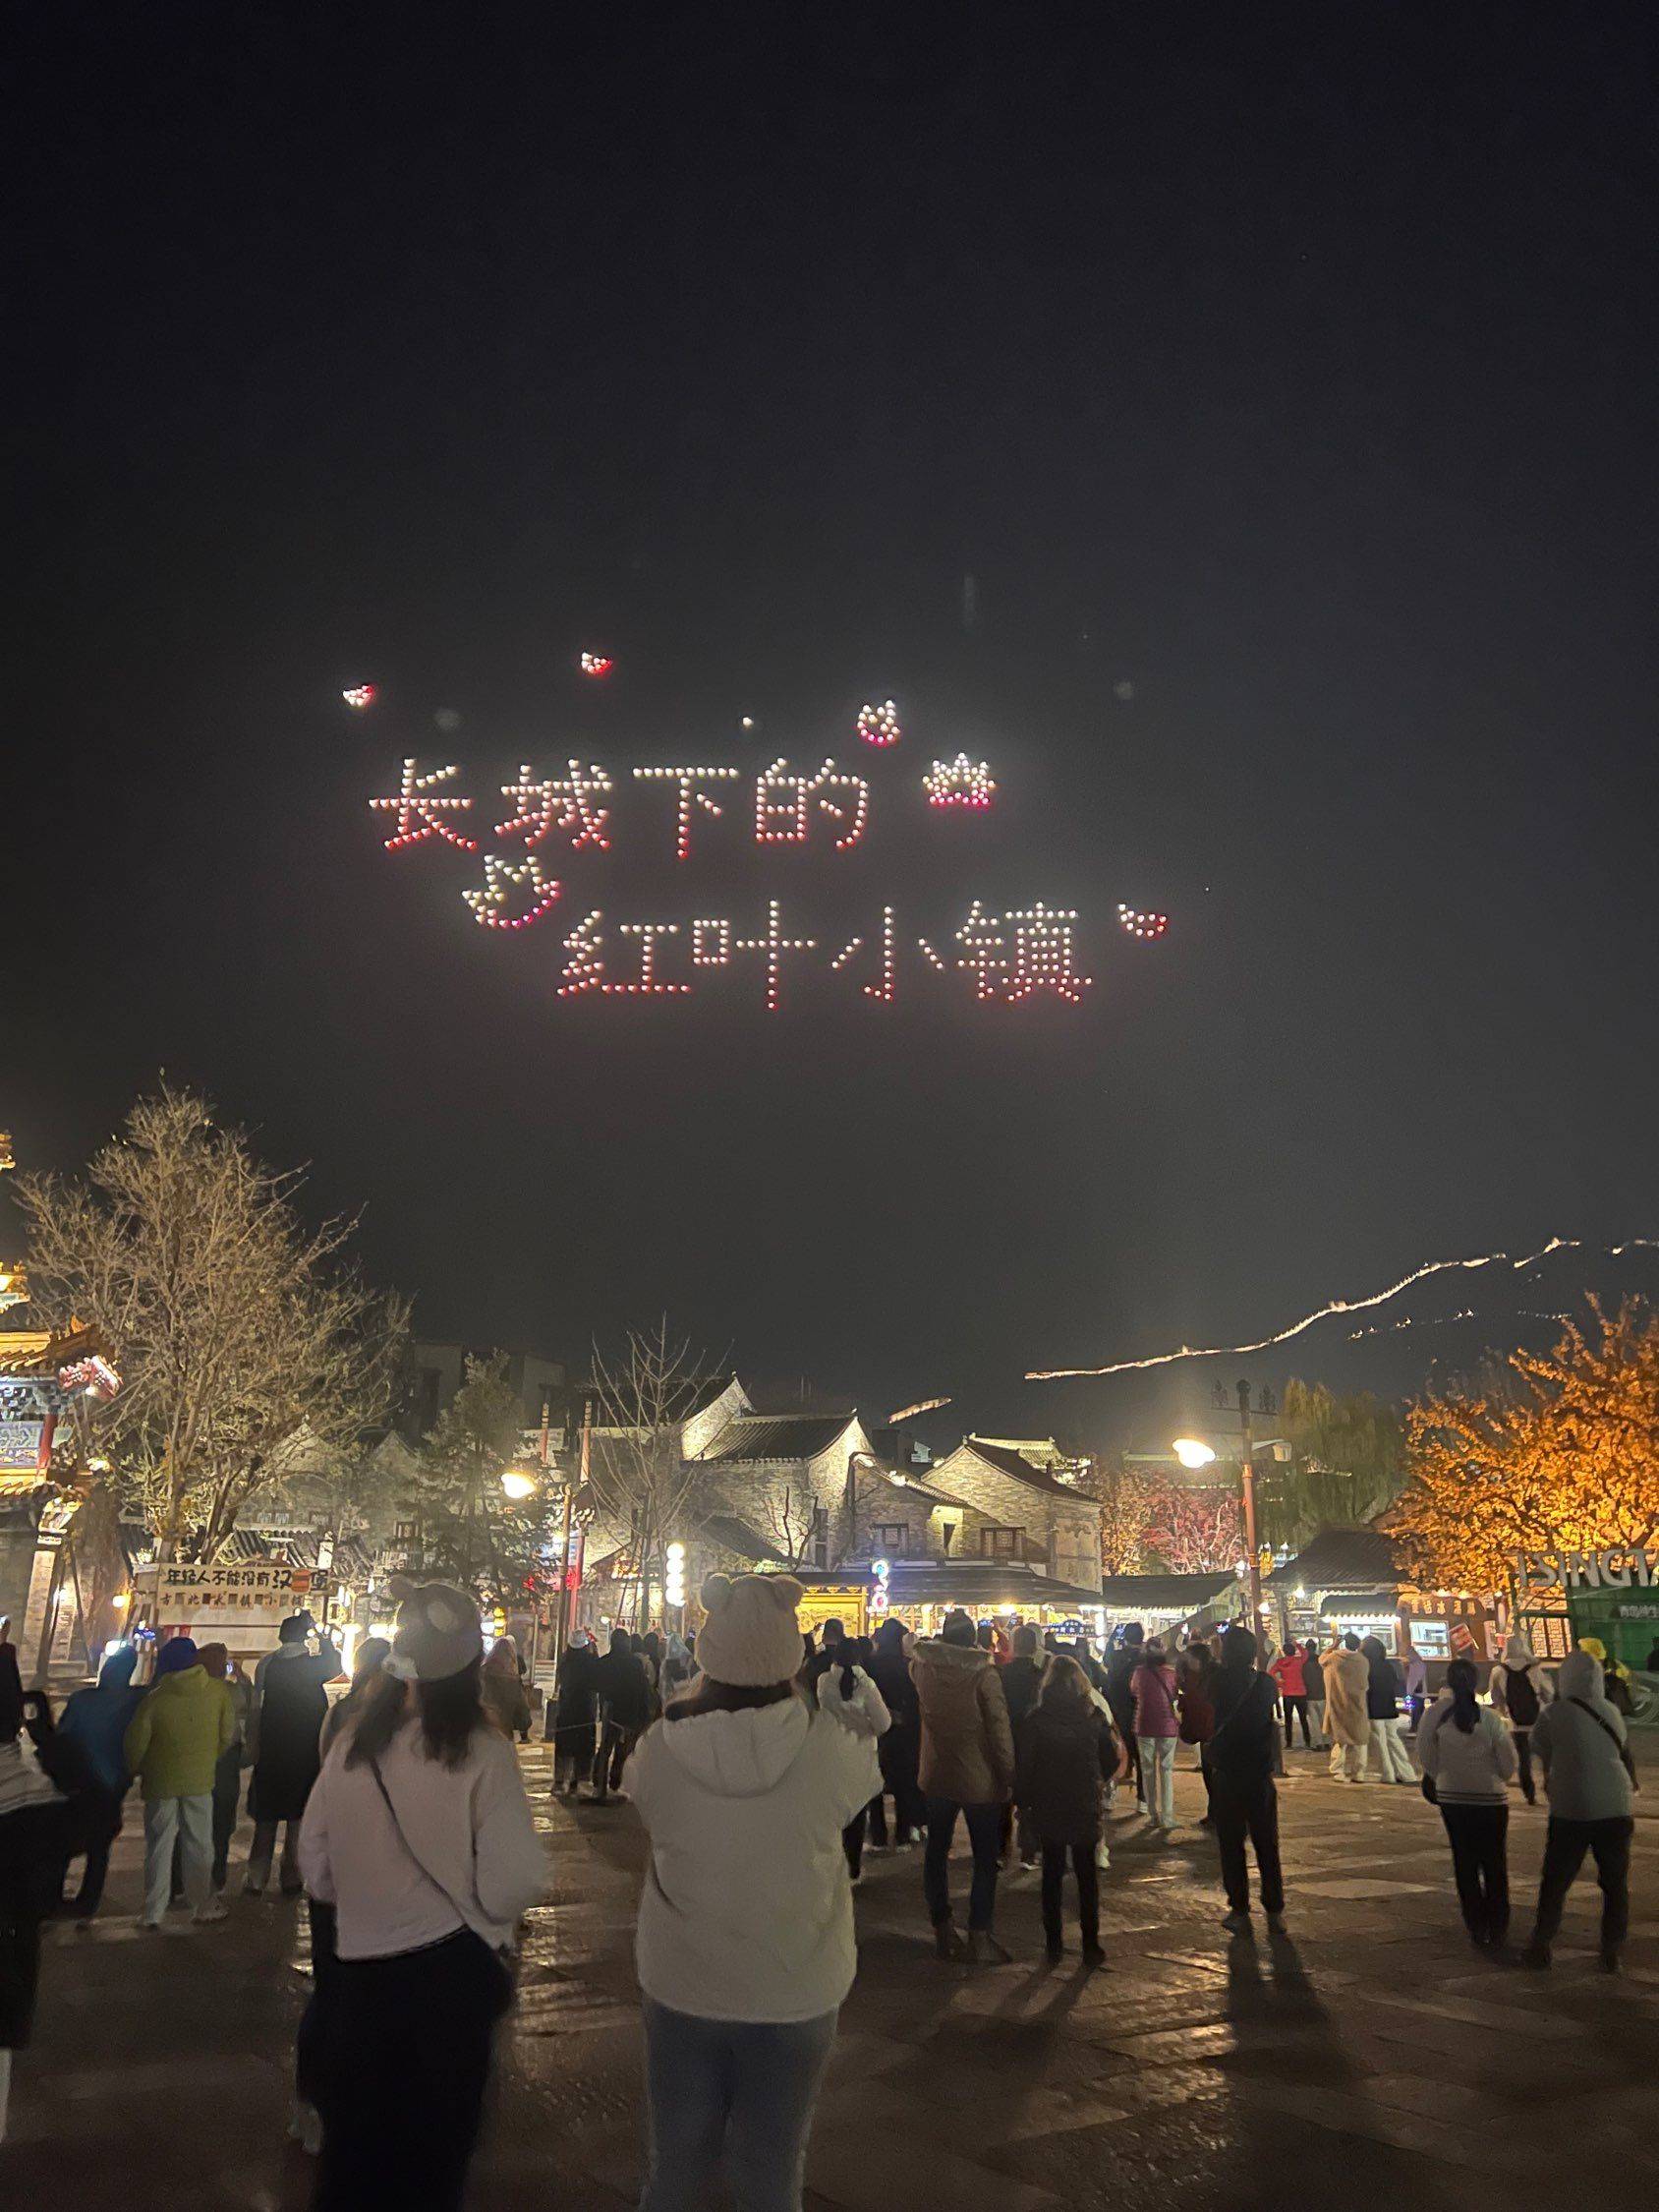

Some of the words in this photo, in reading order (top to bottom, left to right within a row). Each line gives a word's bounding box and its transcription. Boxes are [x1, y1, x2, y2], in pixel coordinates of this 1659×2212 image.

[368, 757, 870, 858] 长城下的
[556, 900, 1093, 1011] 红叶小镇
